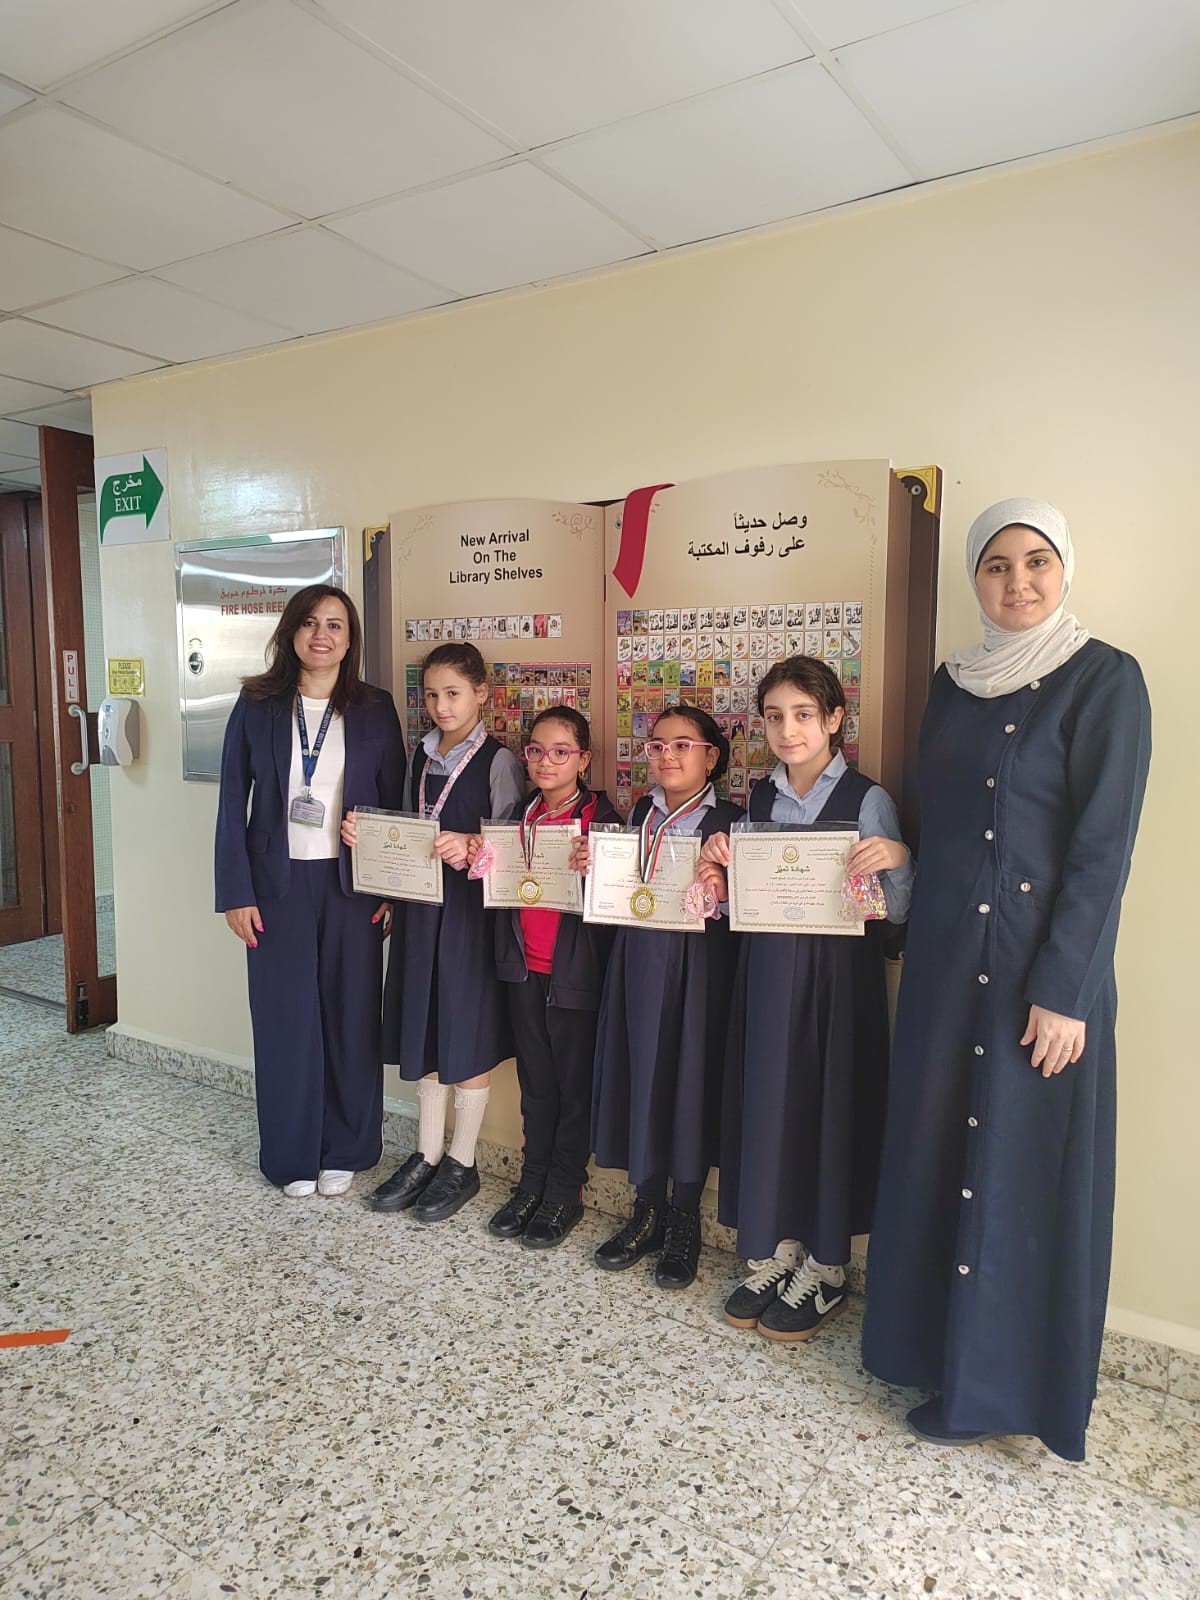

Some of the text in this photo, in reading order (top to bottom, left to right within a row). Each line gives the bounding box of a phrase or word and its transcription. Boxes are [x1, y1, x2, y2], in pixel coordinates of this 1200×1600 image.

[112, 475, 142, 495] مخرج
[115, 495, 141, 512] EXIT
[772, 512, 807, 530] وصل
[461, 528, 529, 547] New Arrival
[473, 550, 516, 564] On The
[688, 536, 805, 560] على رفوف المكتبة
[449, 567, 542, 584] Library Shelves
[221, 604, 239, 616] FIRE
[241, 602, 264, 614] HOSE
[67, 655, 75, 699] PULL
